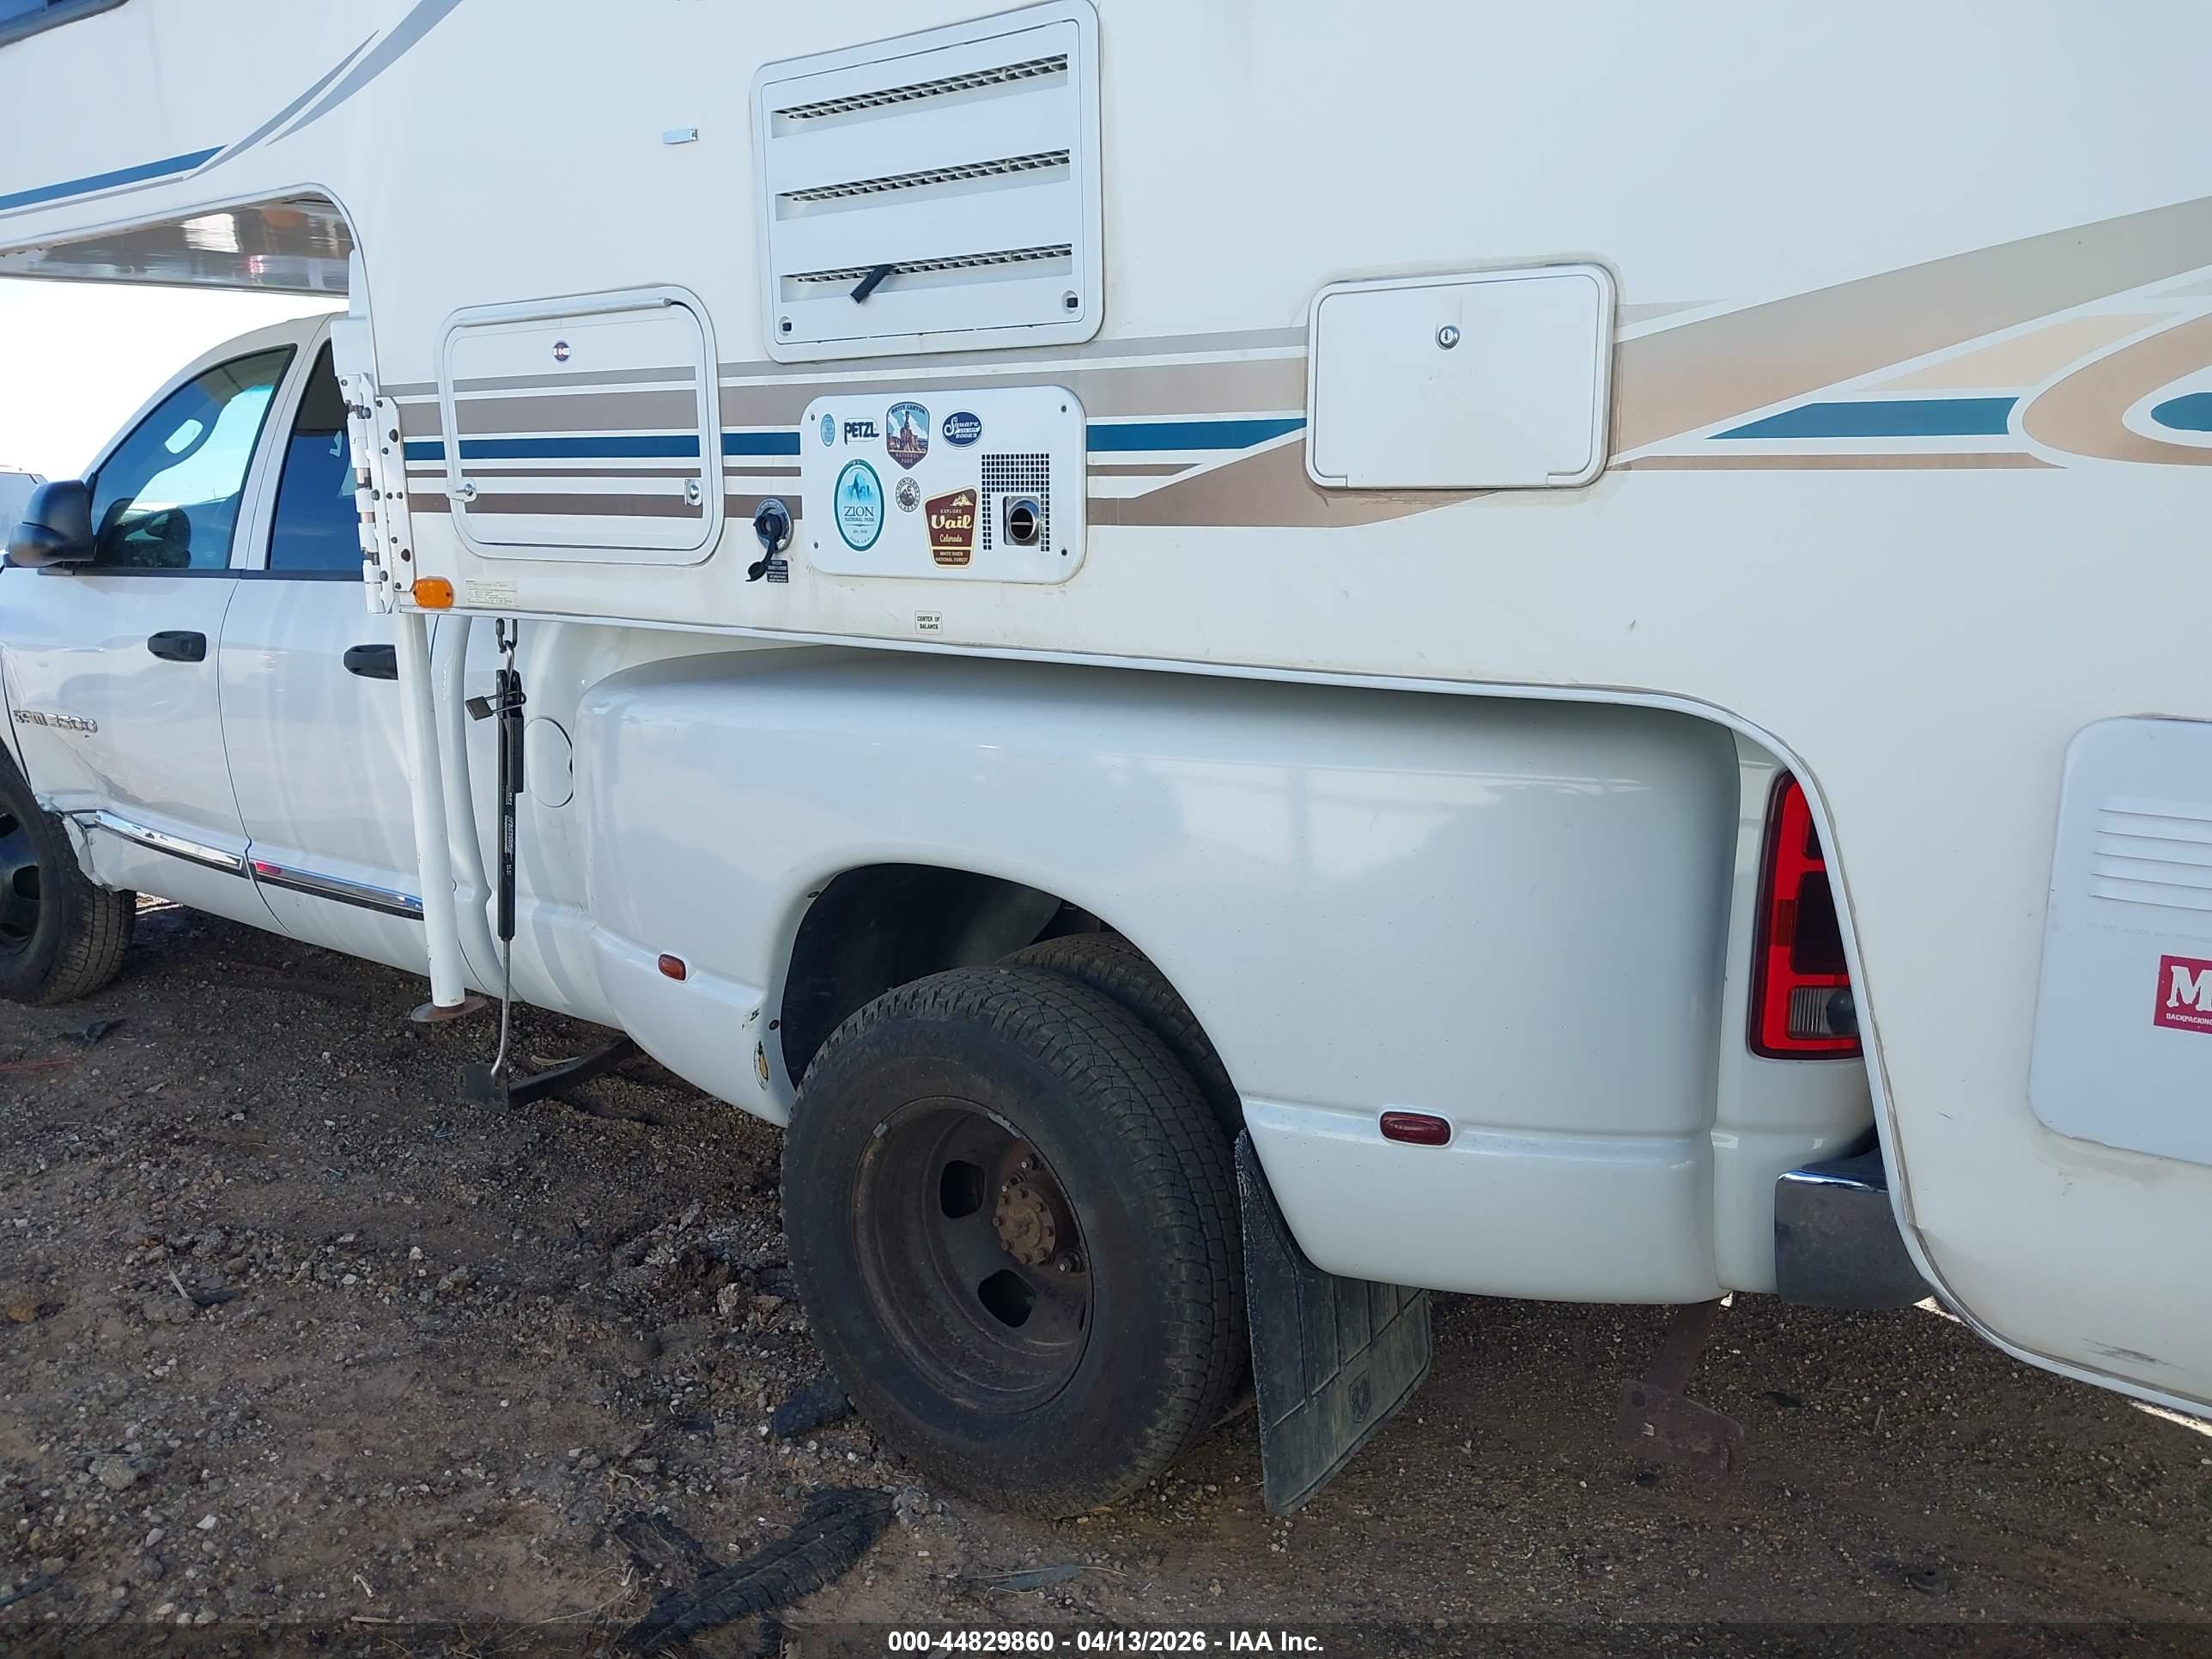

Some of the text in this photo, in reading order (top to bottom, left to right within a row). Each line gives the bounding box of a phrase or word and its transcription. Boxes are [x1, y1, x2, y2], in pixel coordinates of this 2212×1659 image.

[945, 416, 979, 436] Square
[844, 422, 879, 445] PETZL
[844, 507, 874, 517] ZION
[931, 515, 973, 529] Vail
[939, 533, 963, 543] Colorado
